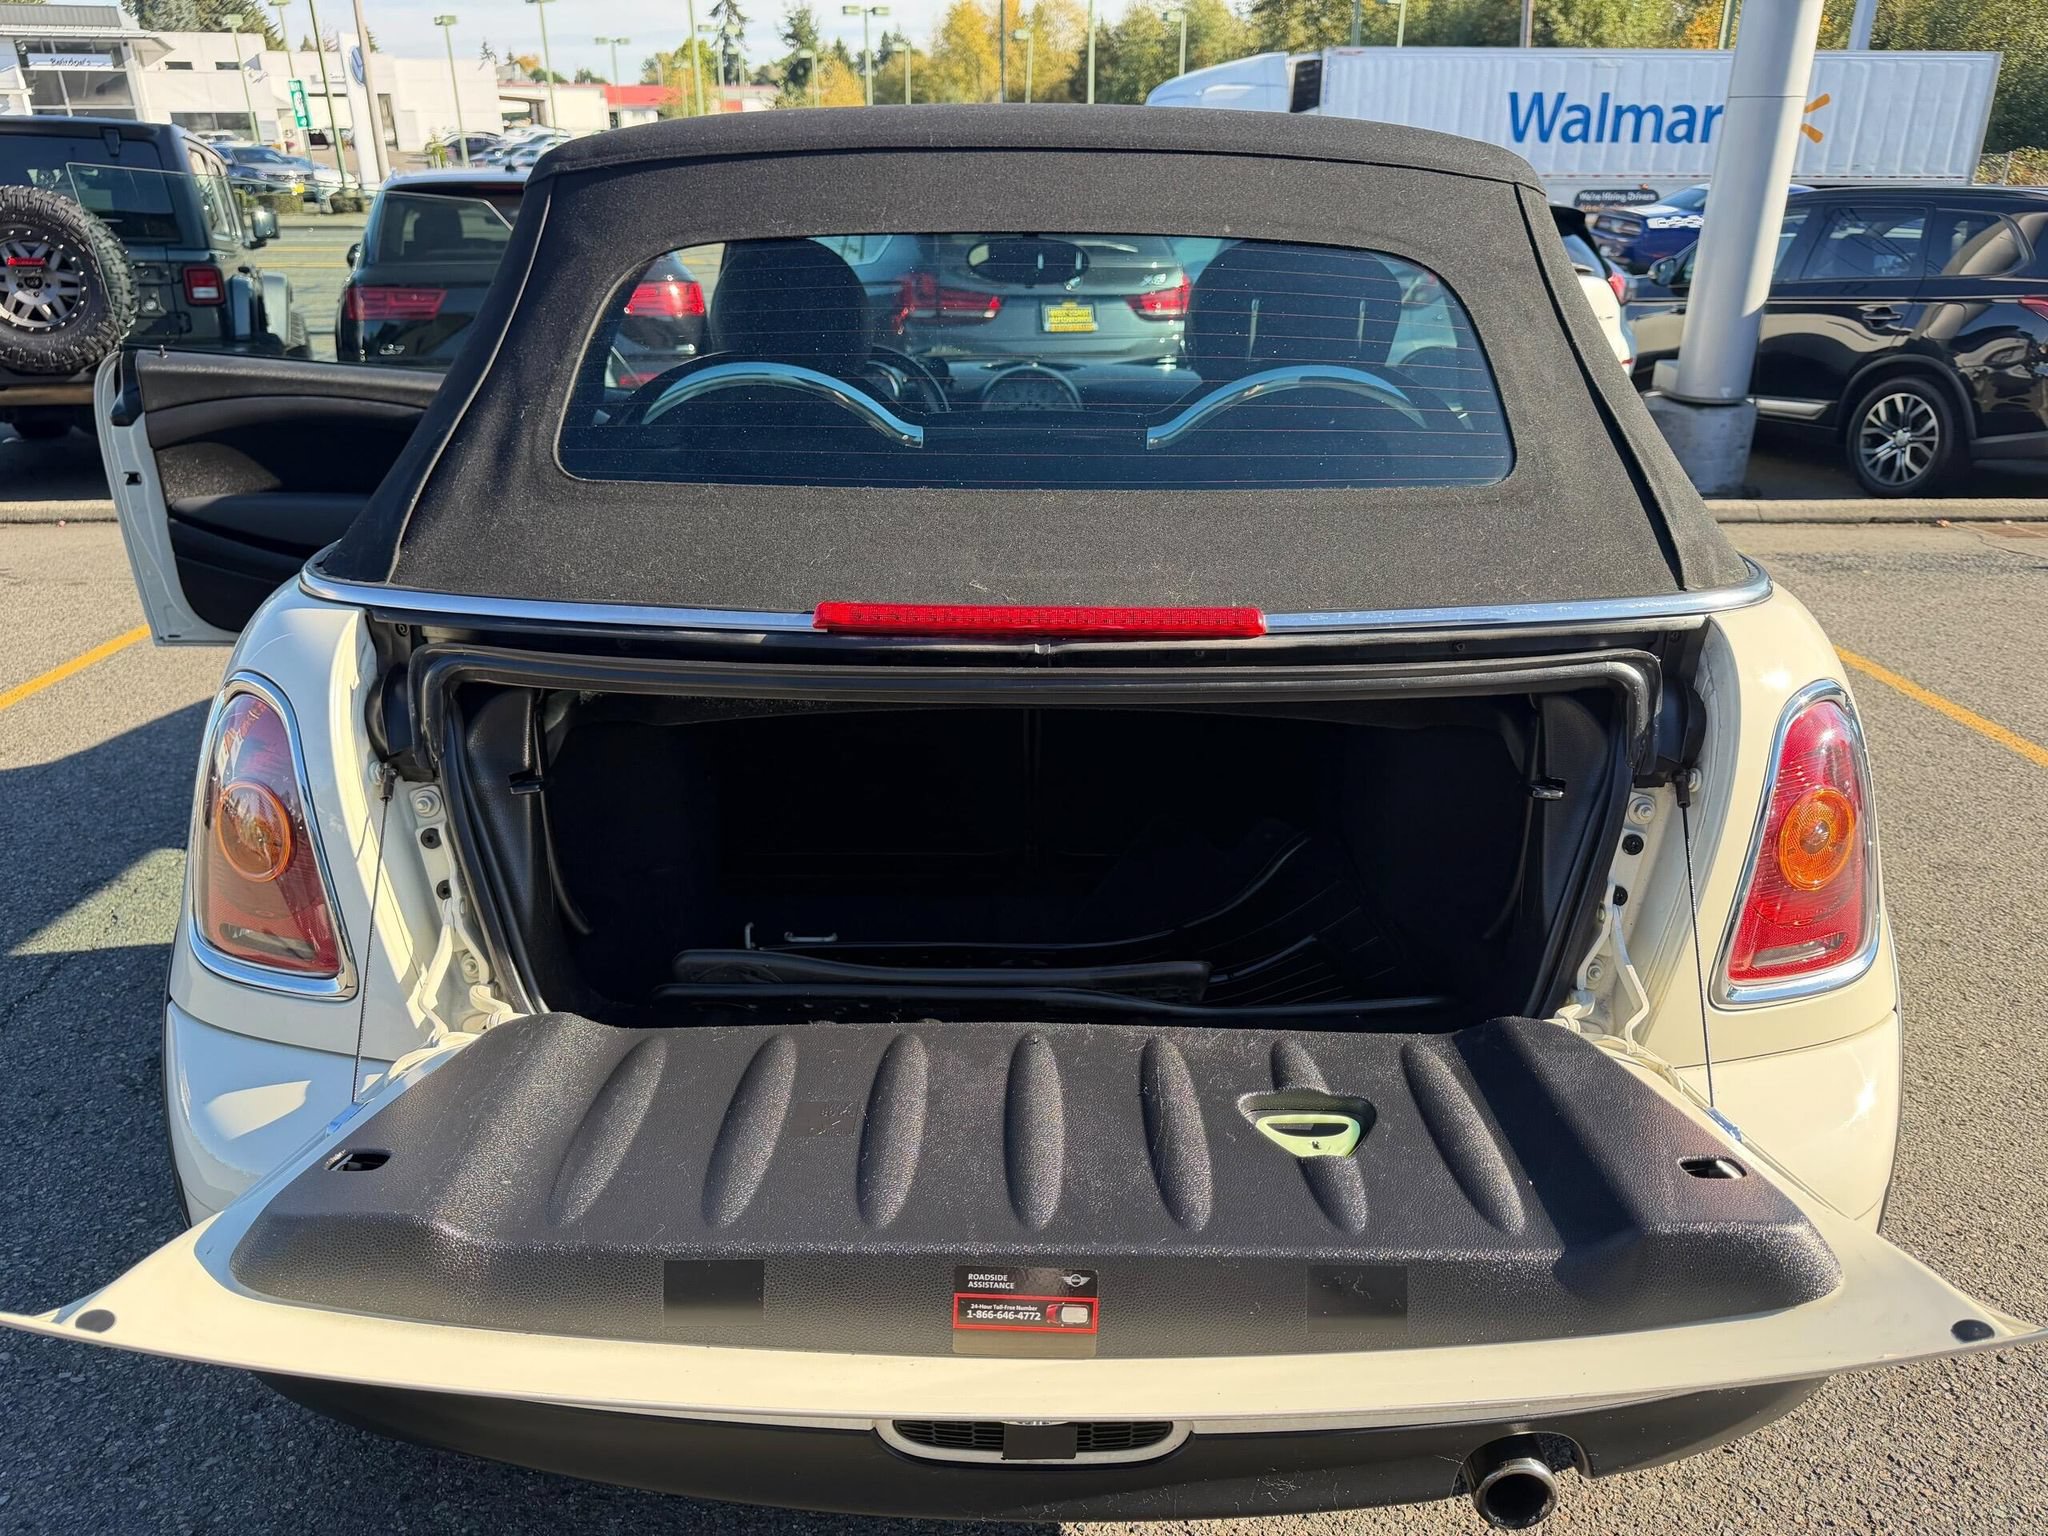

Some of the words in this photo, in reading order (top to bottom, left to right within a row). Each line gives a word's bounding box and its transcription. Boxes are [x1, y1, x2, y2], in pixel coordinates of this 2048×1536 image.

[1508, 91, 1725, 144] Walmar
[967, 1273, 1008, 1282] ROADSIDE
[967, 1281, 1015, 1289] ASSISTANCE
[966, 1309, 1041, 1321] 1-866-646-4772
